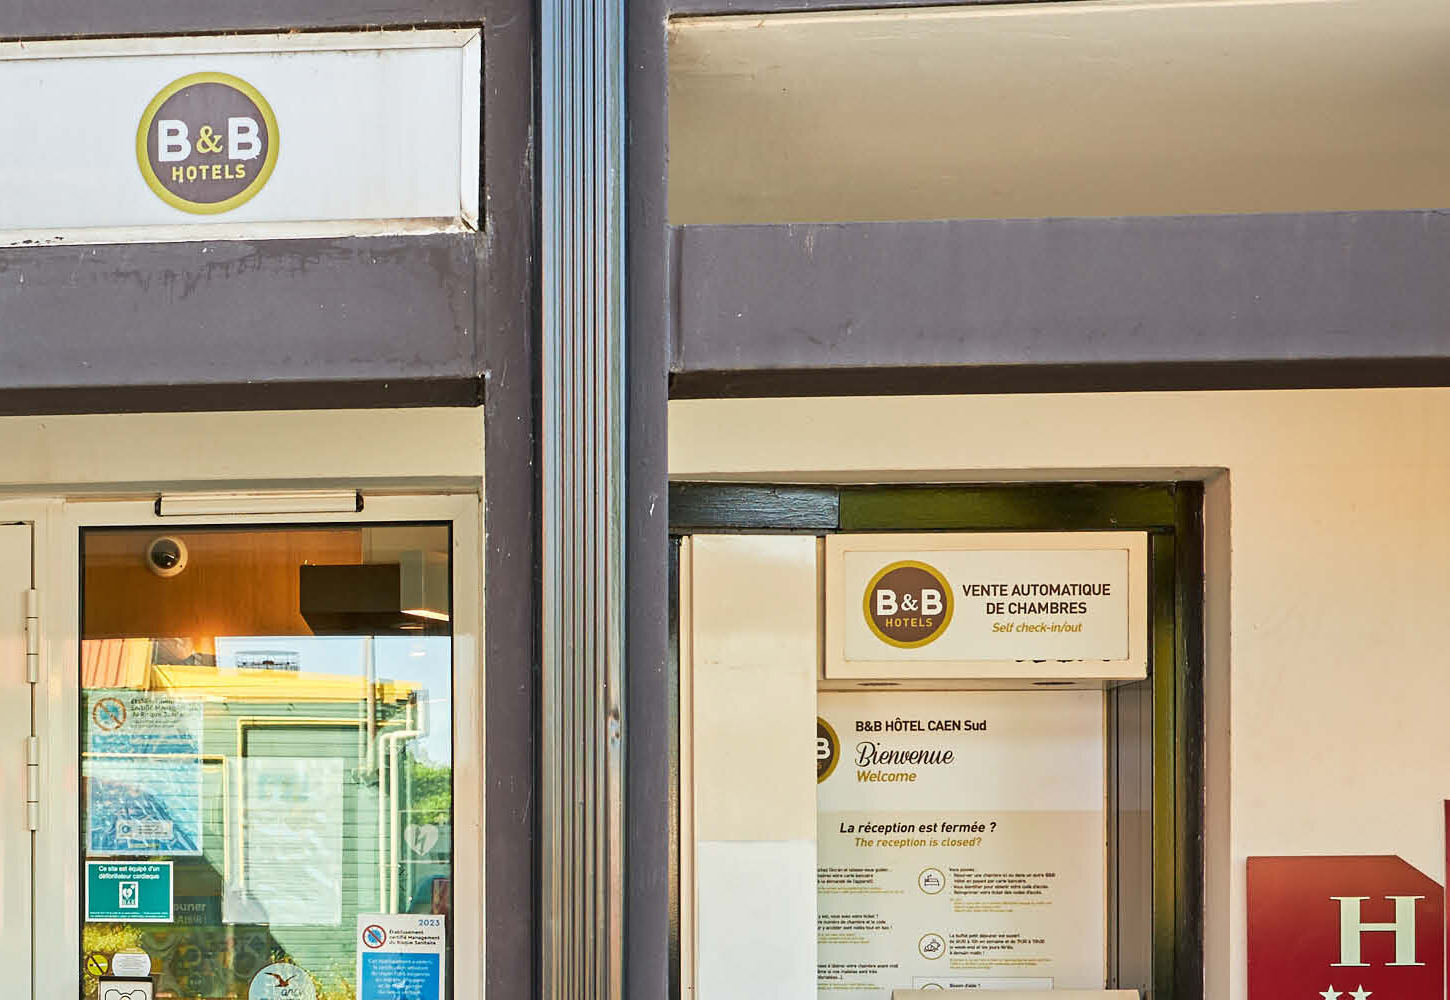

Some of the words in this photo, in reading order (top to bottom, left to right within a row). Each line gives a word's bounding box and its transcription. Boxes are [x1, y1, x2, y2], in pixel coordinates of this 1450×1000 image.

[158, 116, 262, 162] B&B
[171, 164, 246, 183] HOTELS
[962, 584, 1009, 597] VENTE
[1011, 583, 1111, 597] AUTOMATIQUE
[876, 589, 943, 615] B&B
[986, 602, 1005, 615] DE
[1008, 601, 1087, 615] CHAMBRES
[885, 617, 933, 628] HOTELS
[992, 622, 1014, 633] Self
[1016, 621, 1082, 633] check-in/out
[855, 721, 882, 732] B&B
[886, 717, 925, 731] HÔTEL
[928, 720, 961, 731] CAEN
[964, 720, 987, 731] Sud
[854, 741, 955, 768] Bienvenue
[856, 770, 917, 782] Welcome
[839, 823, 855, 833] La
[858, 822, 915, 835] réception
[918, 823, 937, 833] est
[940, 821, 986, 833] fermée
[989, 822, 997, 832] ?
[854, 837, 874, 847] The
[876, 837, 928, 848] reception
[929, 837, 939, 847] is
[941, 837, 982, 847] closed?
[418, 919, 440, 927] 2023
[1330, 895, 1426, 967] H
